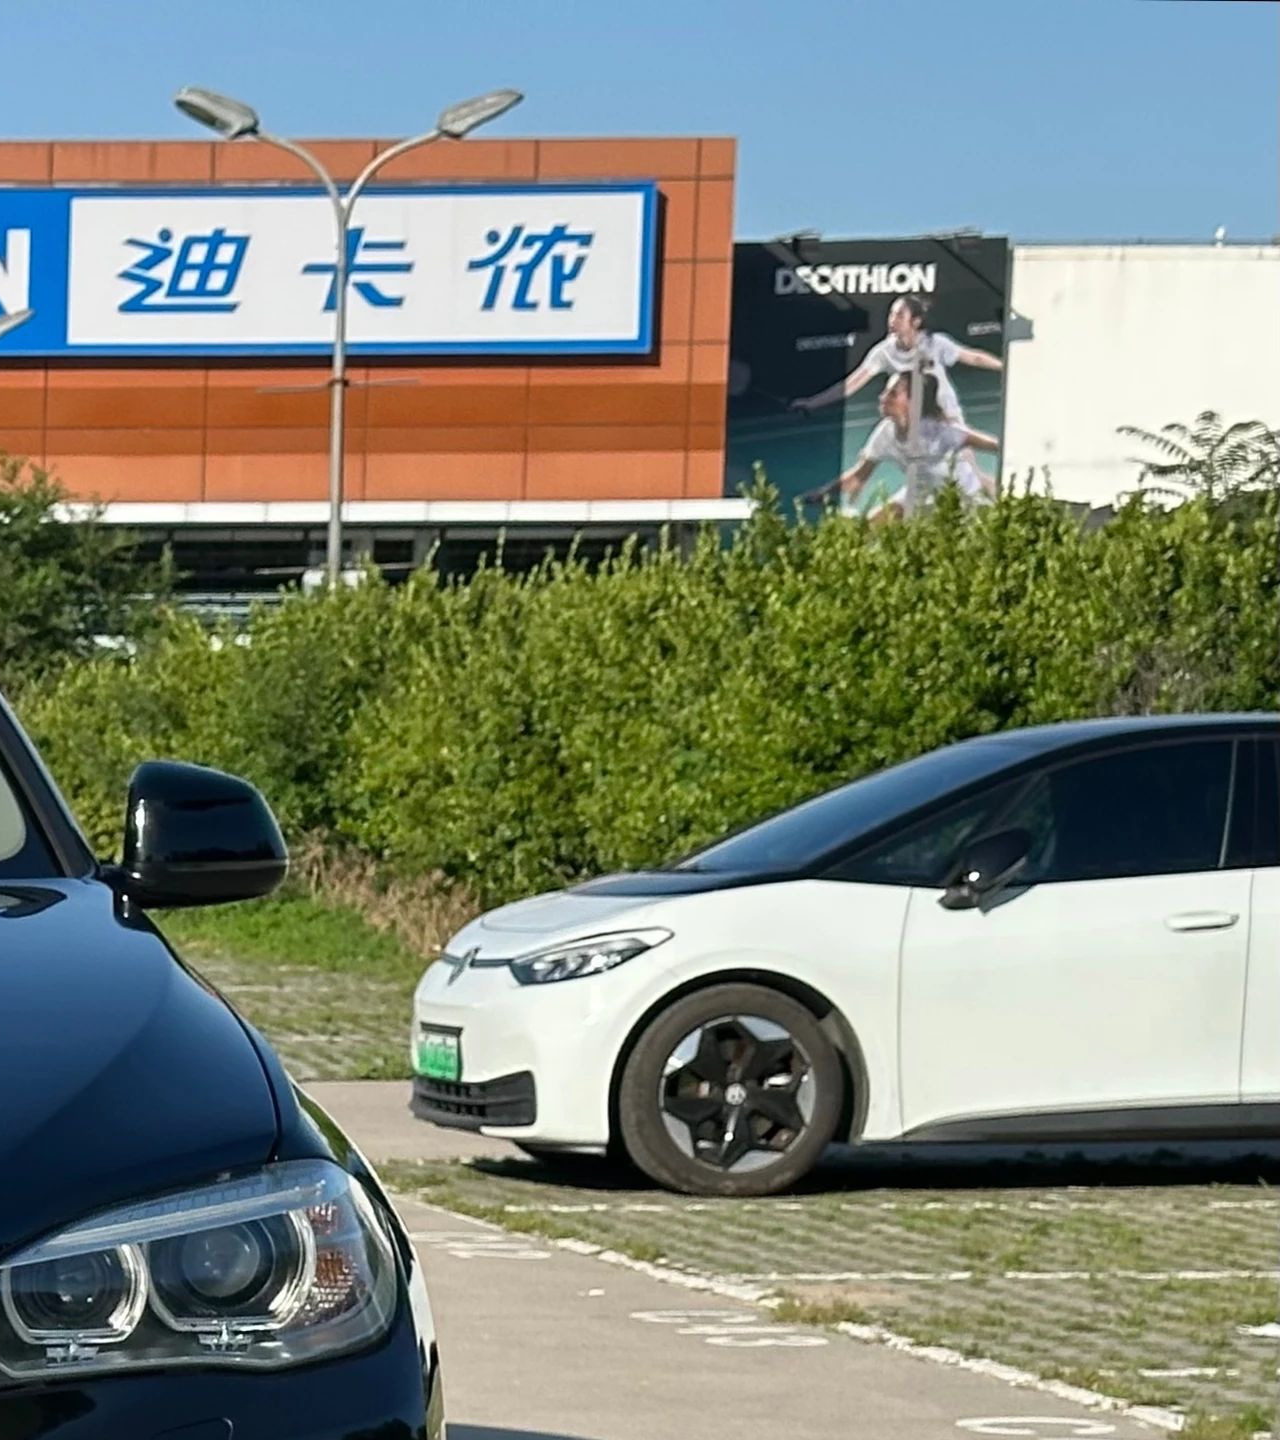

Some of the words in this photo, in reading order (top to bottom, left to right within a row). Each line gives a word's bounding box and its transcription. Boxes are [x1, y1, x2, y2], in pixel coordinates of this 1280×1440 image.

[115, 223, 594, 312] 迪卡侬
[775, 263, 937, 294] DECATHLON
